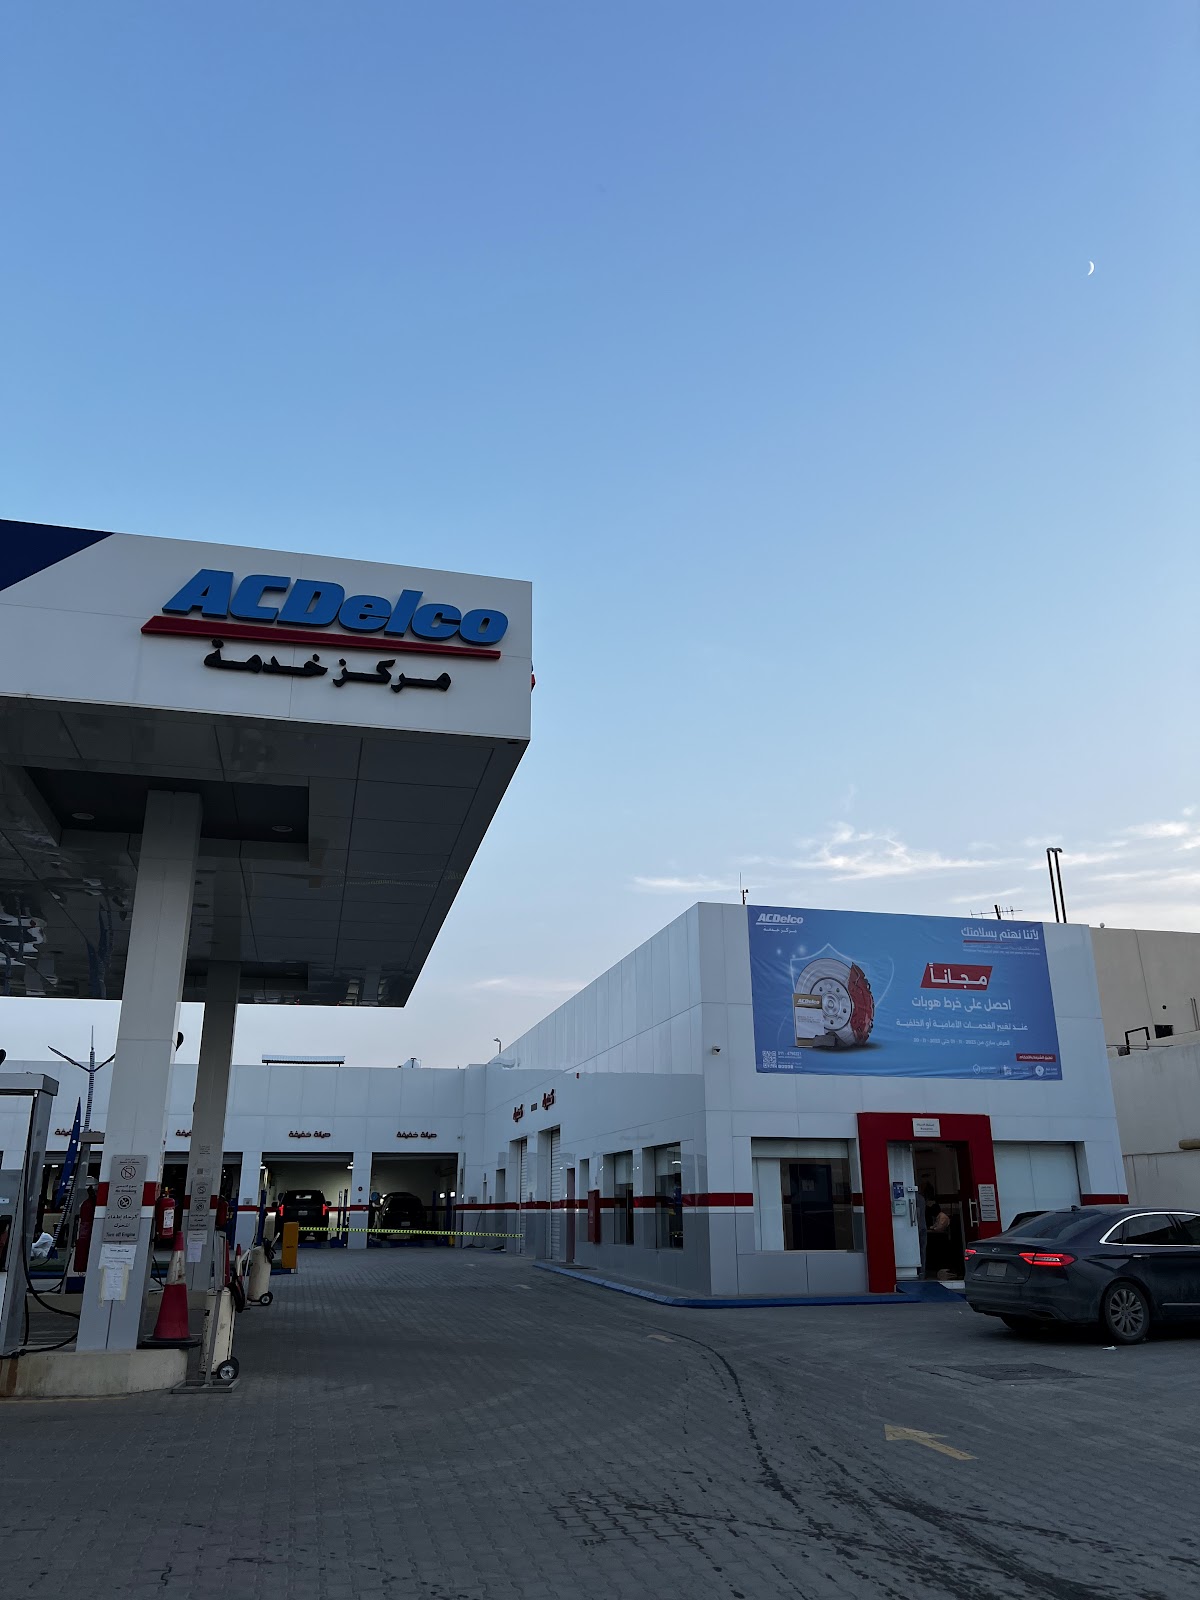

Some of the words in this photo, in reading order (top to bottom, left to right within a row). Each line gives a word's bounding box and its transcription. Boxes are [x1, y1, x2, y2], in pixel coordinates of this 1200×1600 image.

[162, 569, 509, 645] ACDelco
[203, 638, 329, 677] خدمة
[332, 658, 452, 693] مركز
[757, 913, 804, 924] ACDelco
[960, 926, 998, 941] بسلامتك
[1000, 929, 1021, 942] نهتم
[911, 995, 942, 1011] هوبات
[943, 996, 962, 1011] خرط
[964, 997, 982, 1012] على
[983, 998, 1012, 1012] احصل
[288, 1130, 312, 1139] خفيفة
[313, 1130, 331, 1139] صيانة
[396, 1131, 419, 1139] خفيفة
